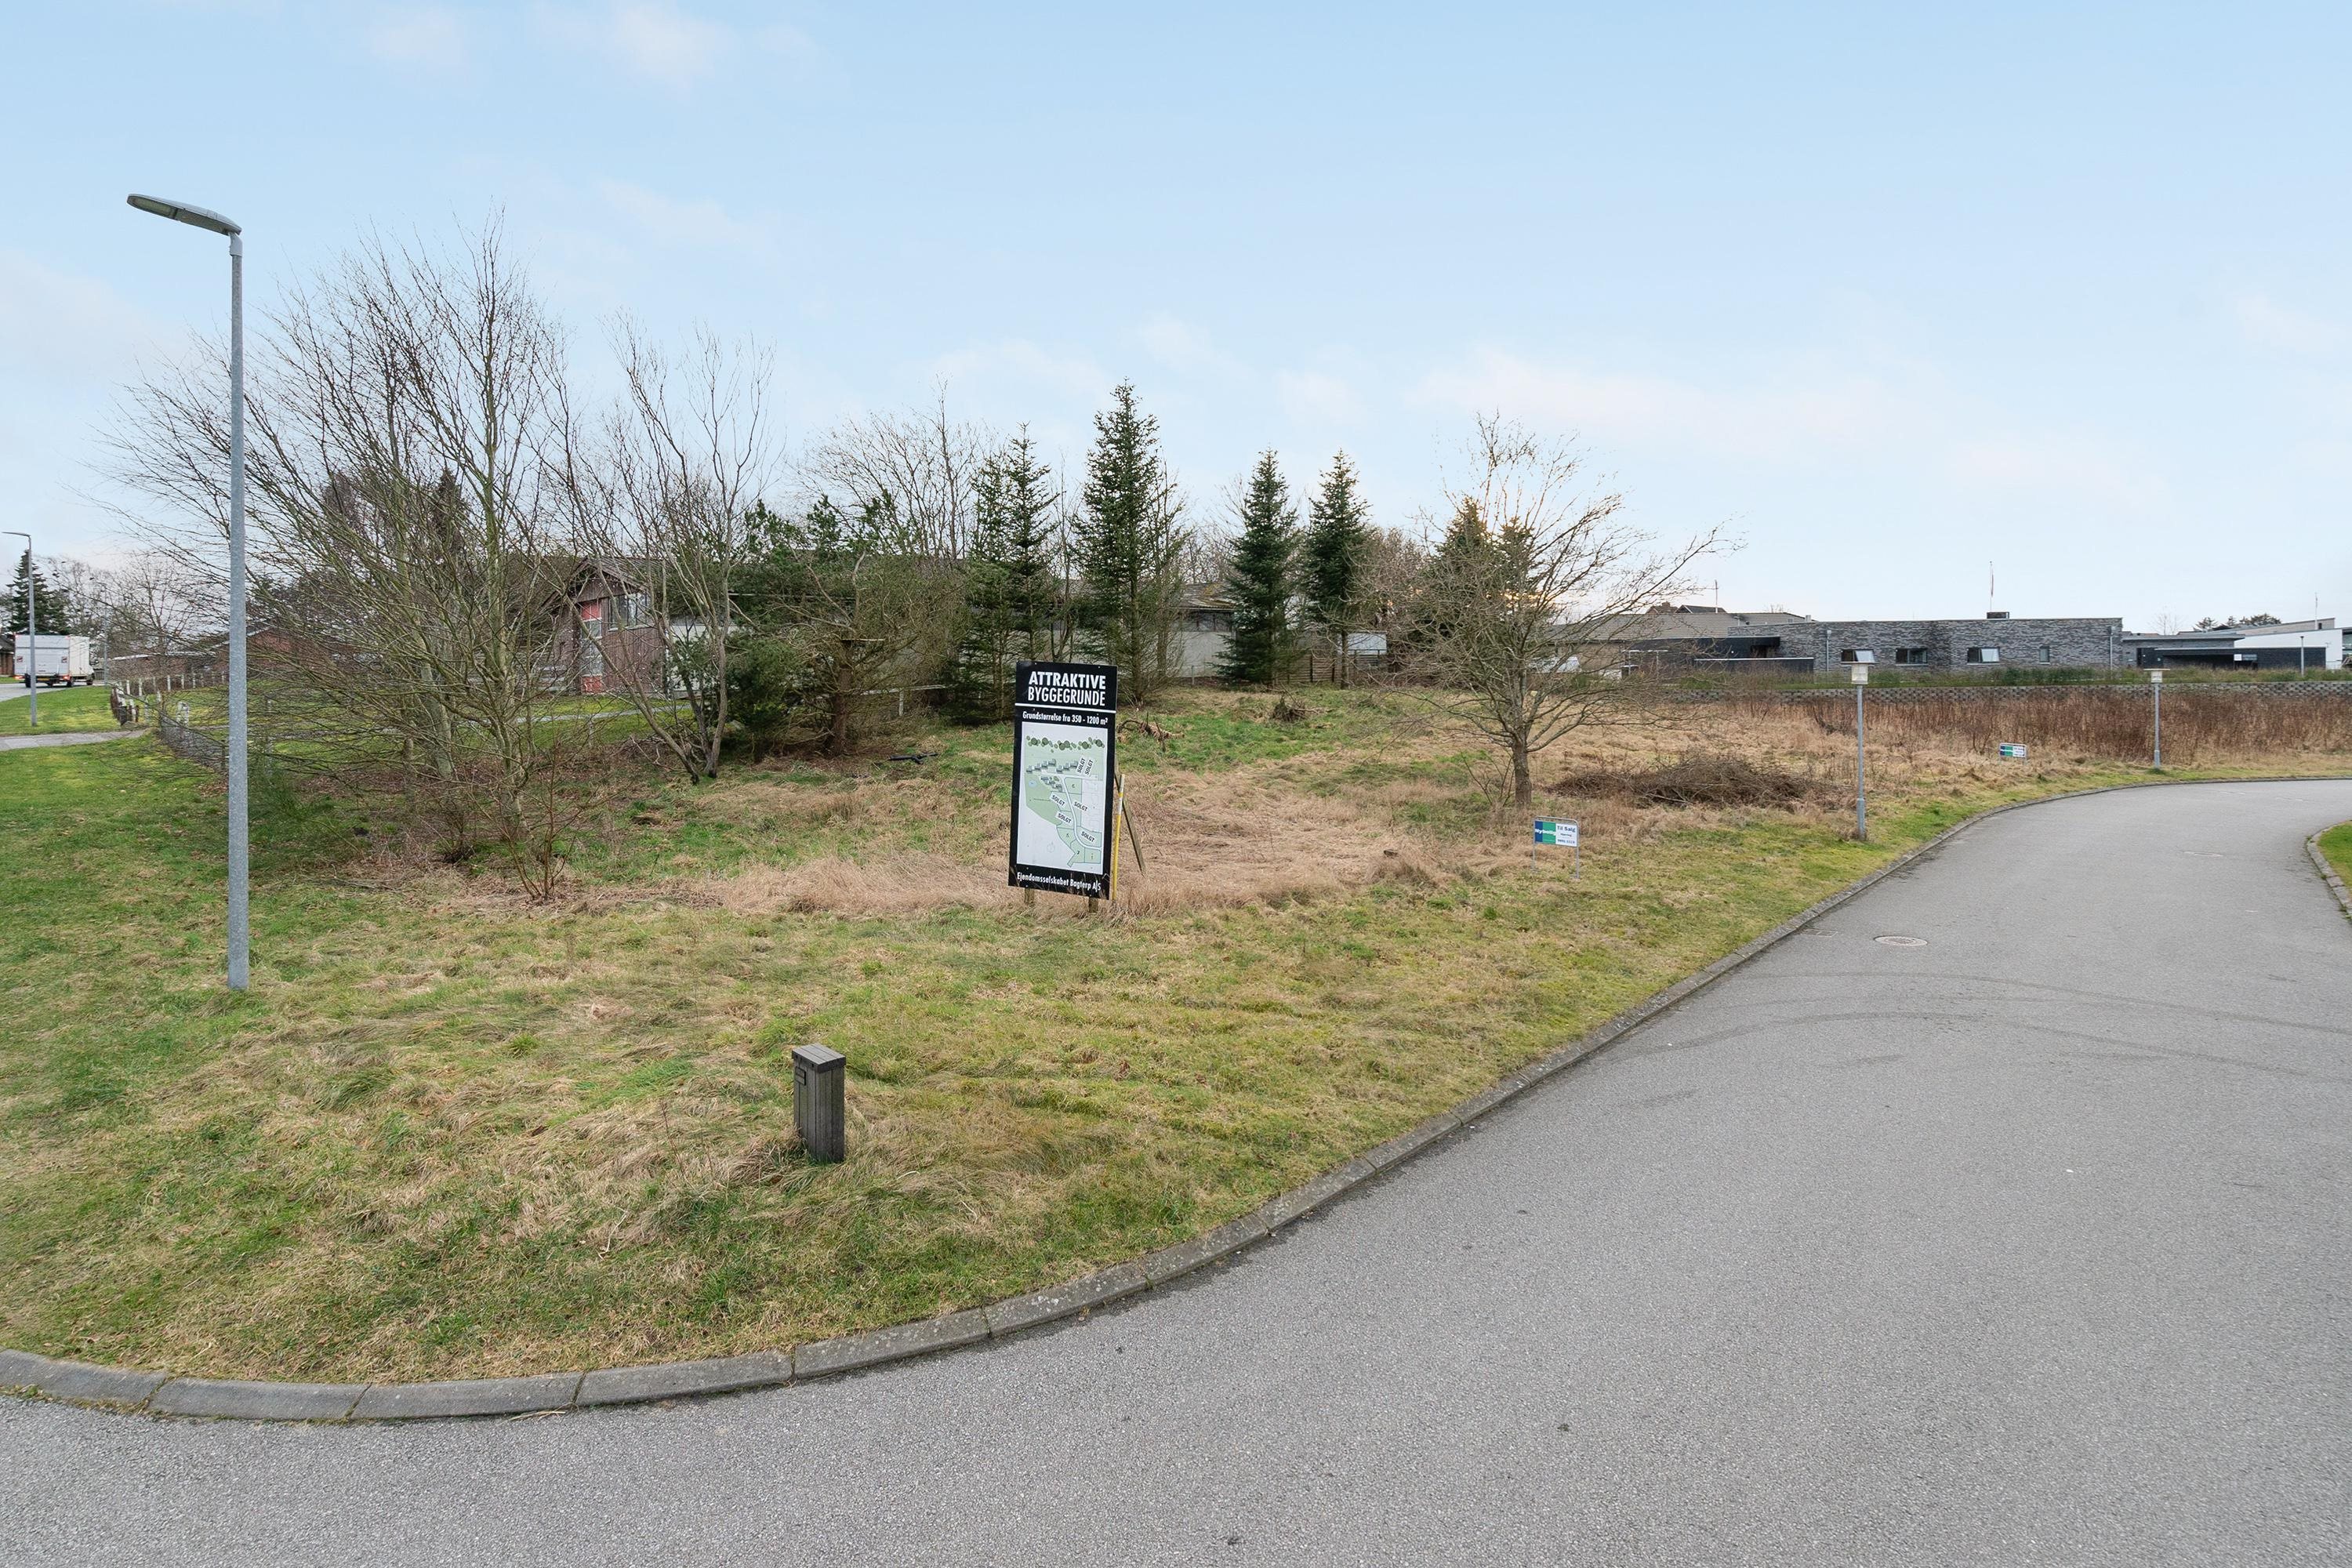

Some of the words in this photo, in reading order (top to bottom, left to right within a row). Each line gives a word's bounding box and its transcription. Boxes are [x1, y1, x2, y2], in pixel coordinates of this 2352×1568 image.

[1029, 671, 1106, 690] ATTRAKTIVE
[1028, 686, 1106, 706] BYGGEGRUNDE
[1072, 714, 1082, 723] 350
[1087, 716, 1099, 724] 1200
[1077, 758, 1086, 773] SOLGT
[1085, 760, 1094, 775] SOLGT
[1051, 795, 1065, 806] SOLGT
[1073, 801, 1088, 811] SOLGT
[1057, 813, 1072, 823] SOLGT
[1081, 831, 1095, 842] SOLGT
[1017, 872, 1069, 886] Ejendomsselskabet
[1069, 878, 1091, 891] Bagterp
